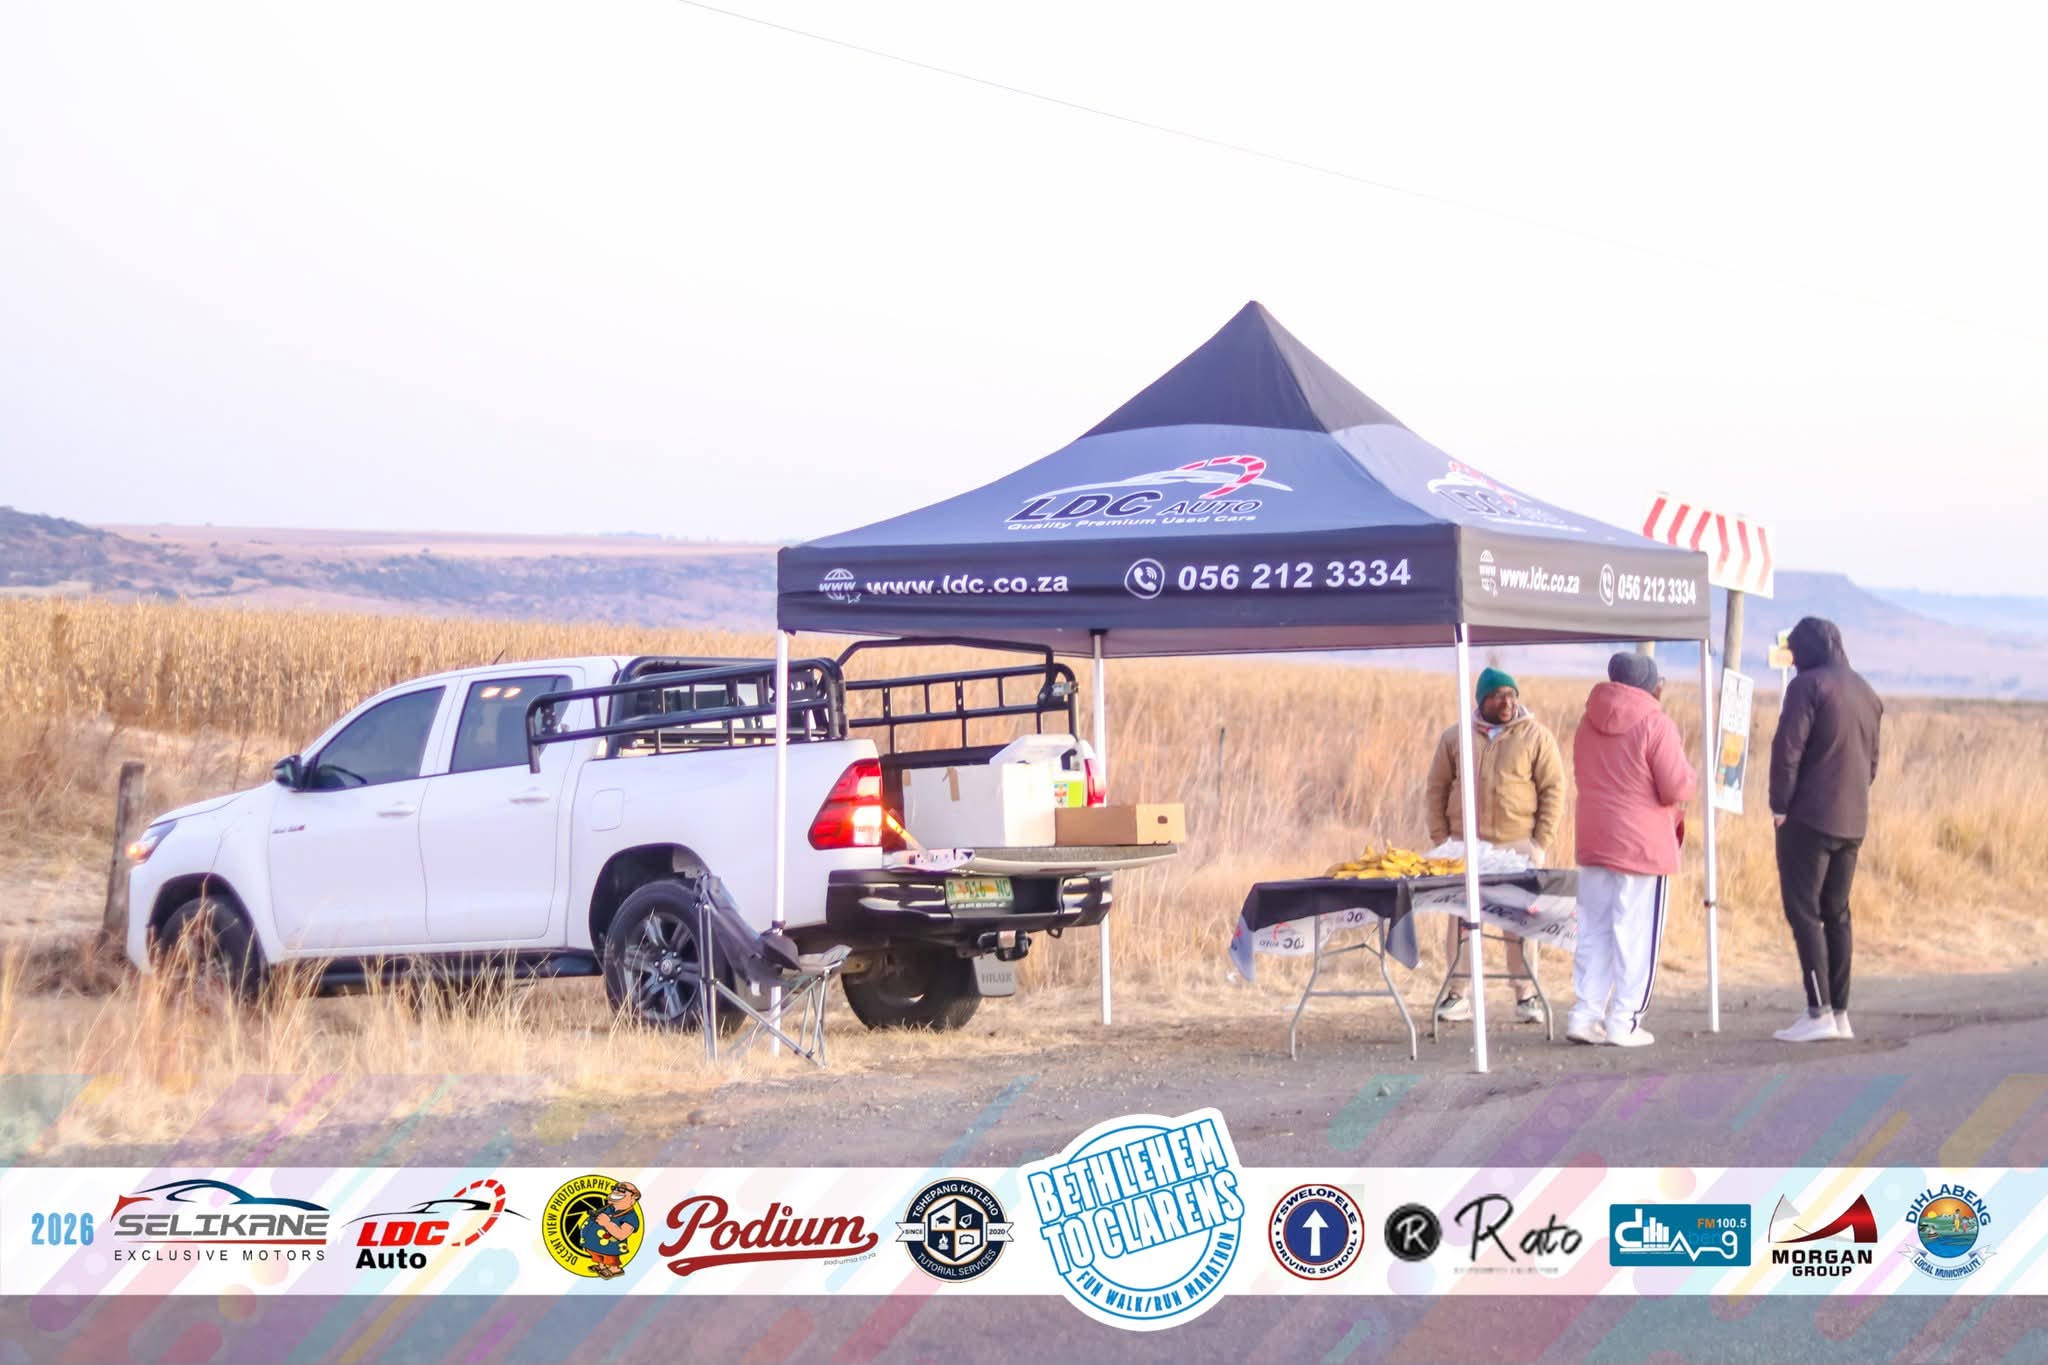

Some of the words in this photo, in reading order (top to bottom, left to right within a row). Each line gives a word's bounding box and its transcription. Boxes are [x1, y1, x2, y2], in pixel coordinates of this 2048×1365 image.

[1004, 491, 1163, 523] LDC
[1157, 500, 1263, 516] AUTO
[1007, 520, 1074, 531] Quality
[1075, 517, 1157, 528] Premium
[1161, 514, 1210, 525] Used
[1214, 514, 1257, 523] Cars
[818, 580, 857, 592] www
[866, 574, 1069, 595] www.ldc.co.za
[1178, 564, 1240, 591] 056
[1251, 562, 1314, 589] 212
[1325, 558, 1411, 588] 3334
[1499, 566, 1580, 594] www.ldc.co.za
[1618, 574, 1641, 601] 056
[1643, 575, 1665, 603] 212
[1668, 578, 1696, 605] 3334
